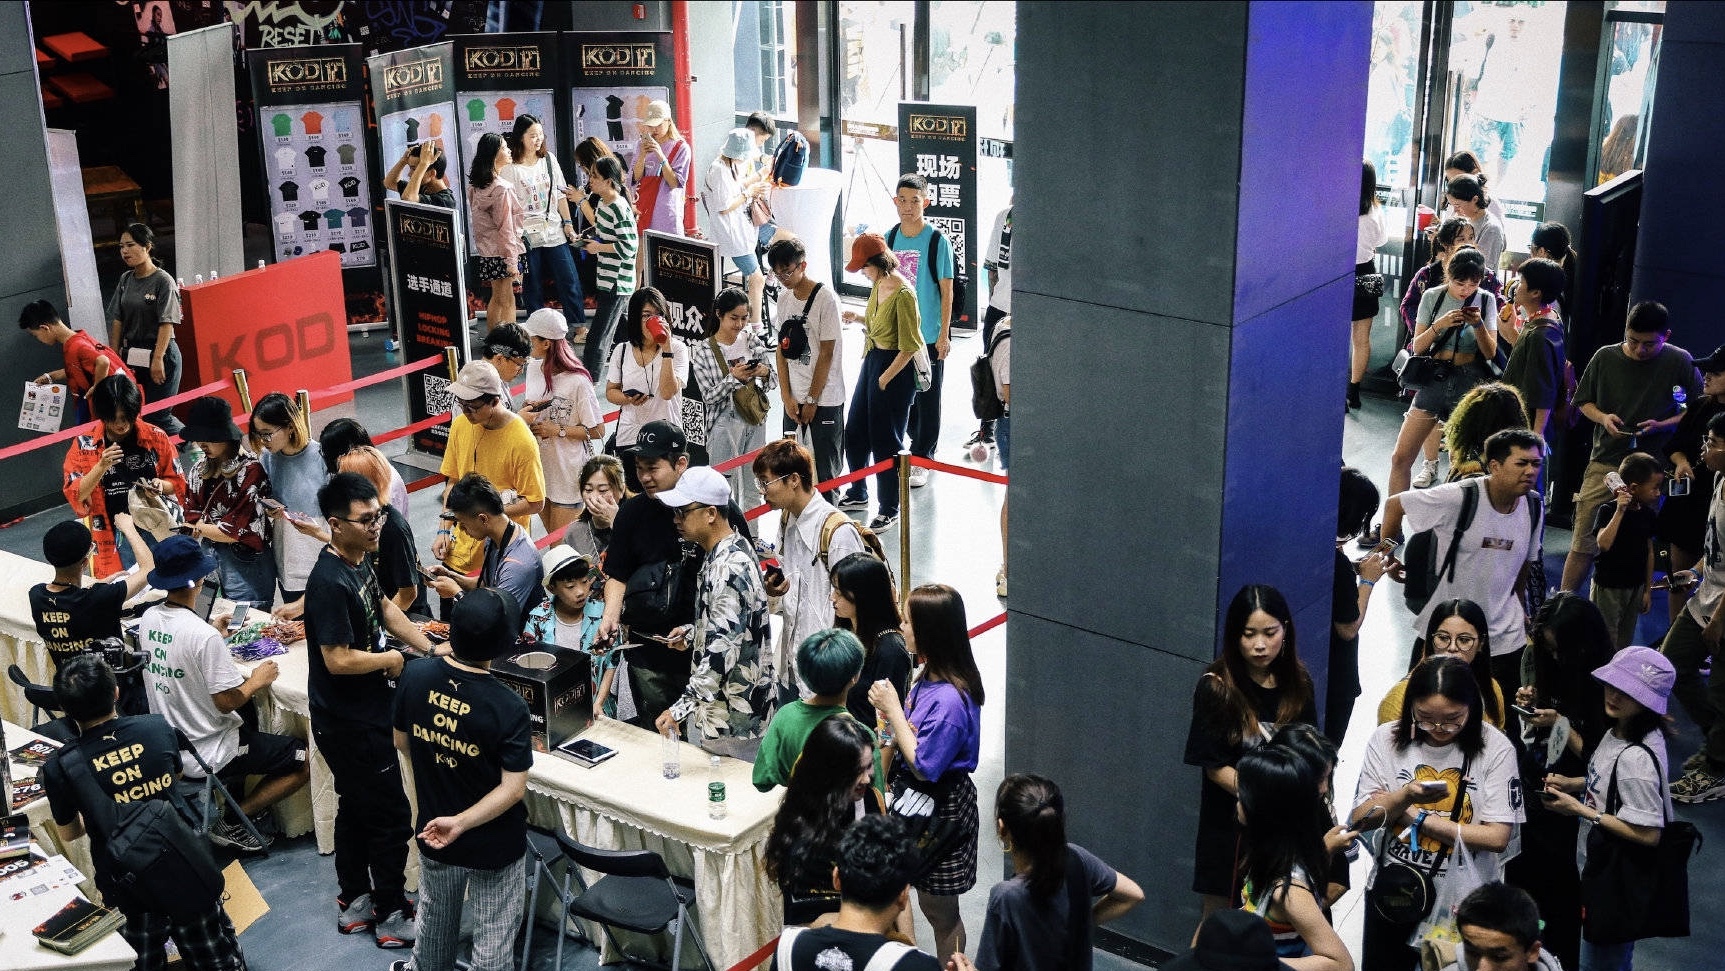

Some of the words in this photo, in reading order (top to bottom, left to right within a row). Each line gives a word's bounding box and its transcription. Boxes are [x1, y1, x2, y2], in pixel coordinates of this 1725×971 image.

[259, 24, 318, 48] RESET
[470, 49, 515, 68] KOD
[586, 47, 631, 65] KOD
[273, 62, 320, 82] KOD
[386, 64, 423, 88] KOD
[913, 116, 948, 131] KOD
[916, 154, 961, 180] 现场
[407, 273, 454, 298] 选手通道
[209, 312, 335, 381] KOD
[42, 611, 70, 623] KEEP
[51, 627, 69, 638] ON
[148, 630, 173, 645] KEEP
[45, 637, 94, 652] ANCING
[154, 647, 167, 661] ON
[144, 662, 185, 679] ANCING
[155, 682, 170, 695] KD
[427, 690, 471, 716] KEEP
[433, 713, 458, 733] ON
[413, 723, 480, 757] DANCING
[92, 743, 145, 772] KEEP
[111, 764, 142, 785] ON
[114, 773, 172, 804] NCING
